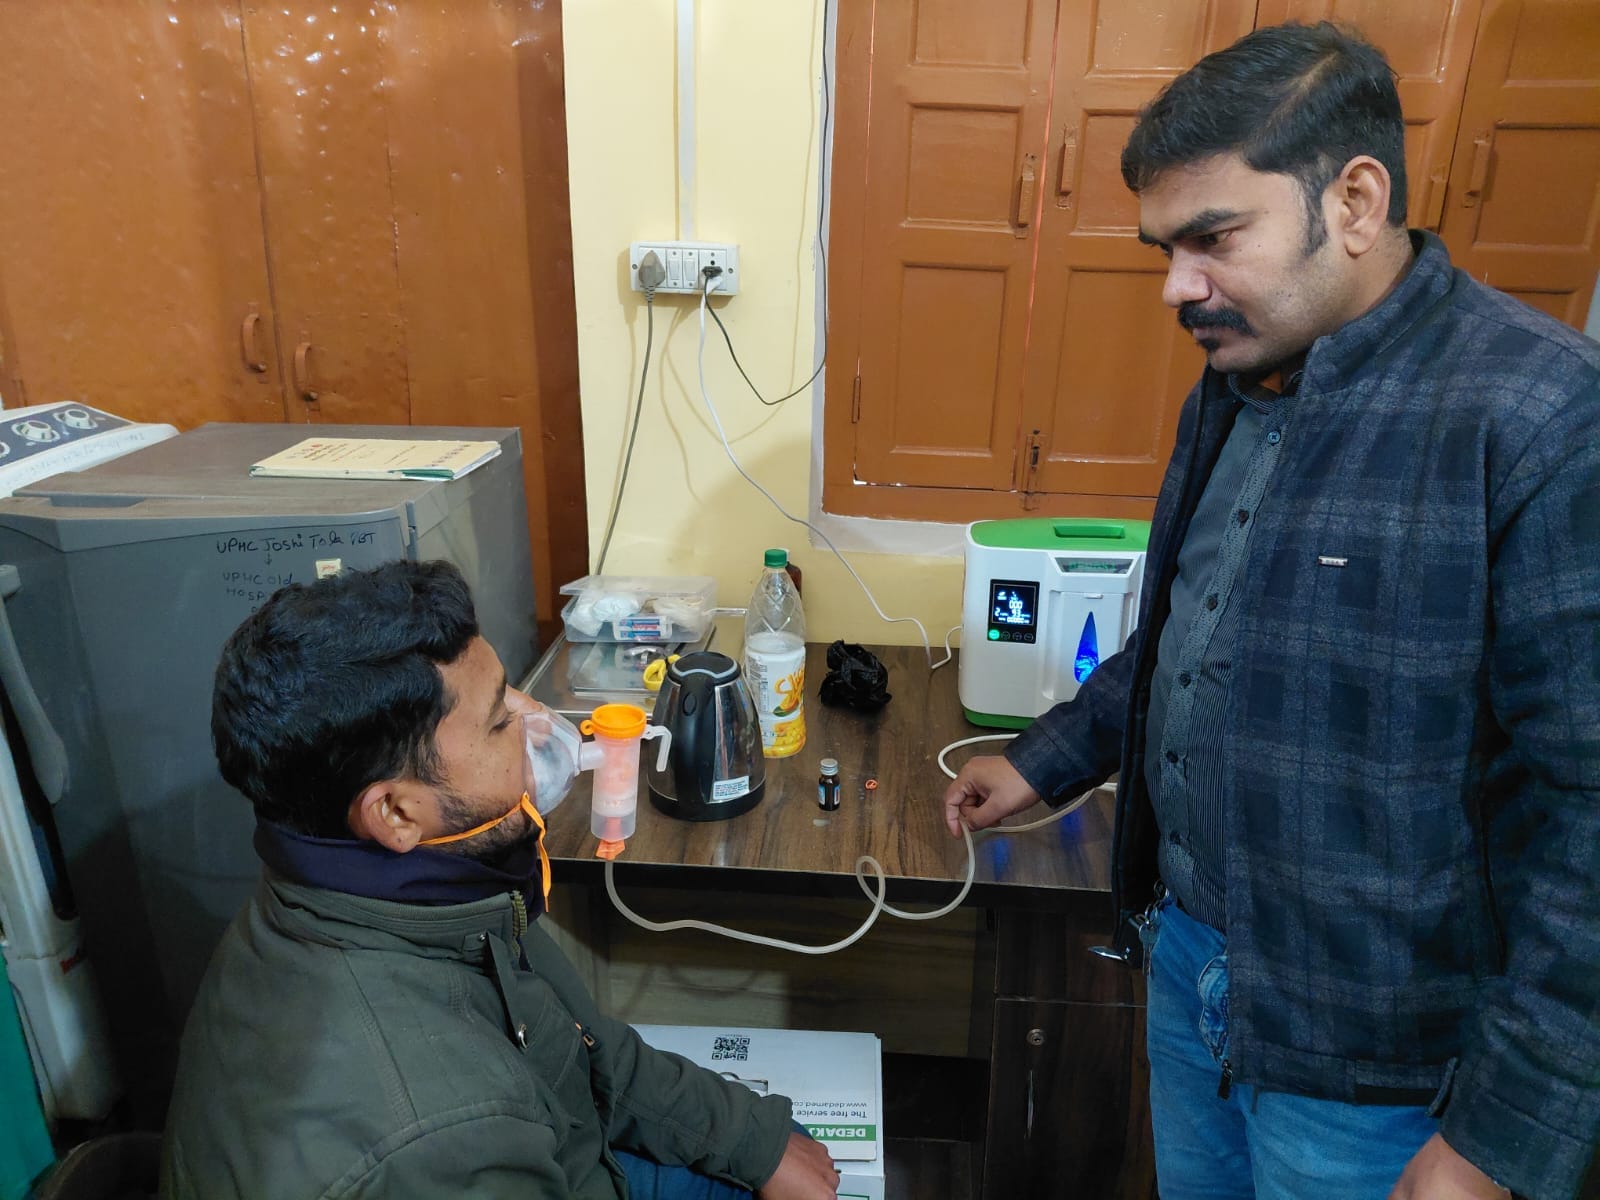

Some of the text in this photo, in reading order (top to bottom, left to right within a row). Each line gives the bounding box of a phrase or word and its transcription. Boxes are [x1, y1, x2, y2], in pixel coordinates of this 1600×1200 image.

[216, 537, 258, 554] UPHC
[223, 571, 263, 585] UPHC
[791, 1100, 868, 1109] www.dedamed.co
[796, 1109, 829, 1118] service
[830, 1110, 848, 1119] free
[850, 1110, 868, 1119] The
